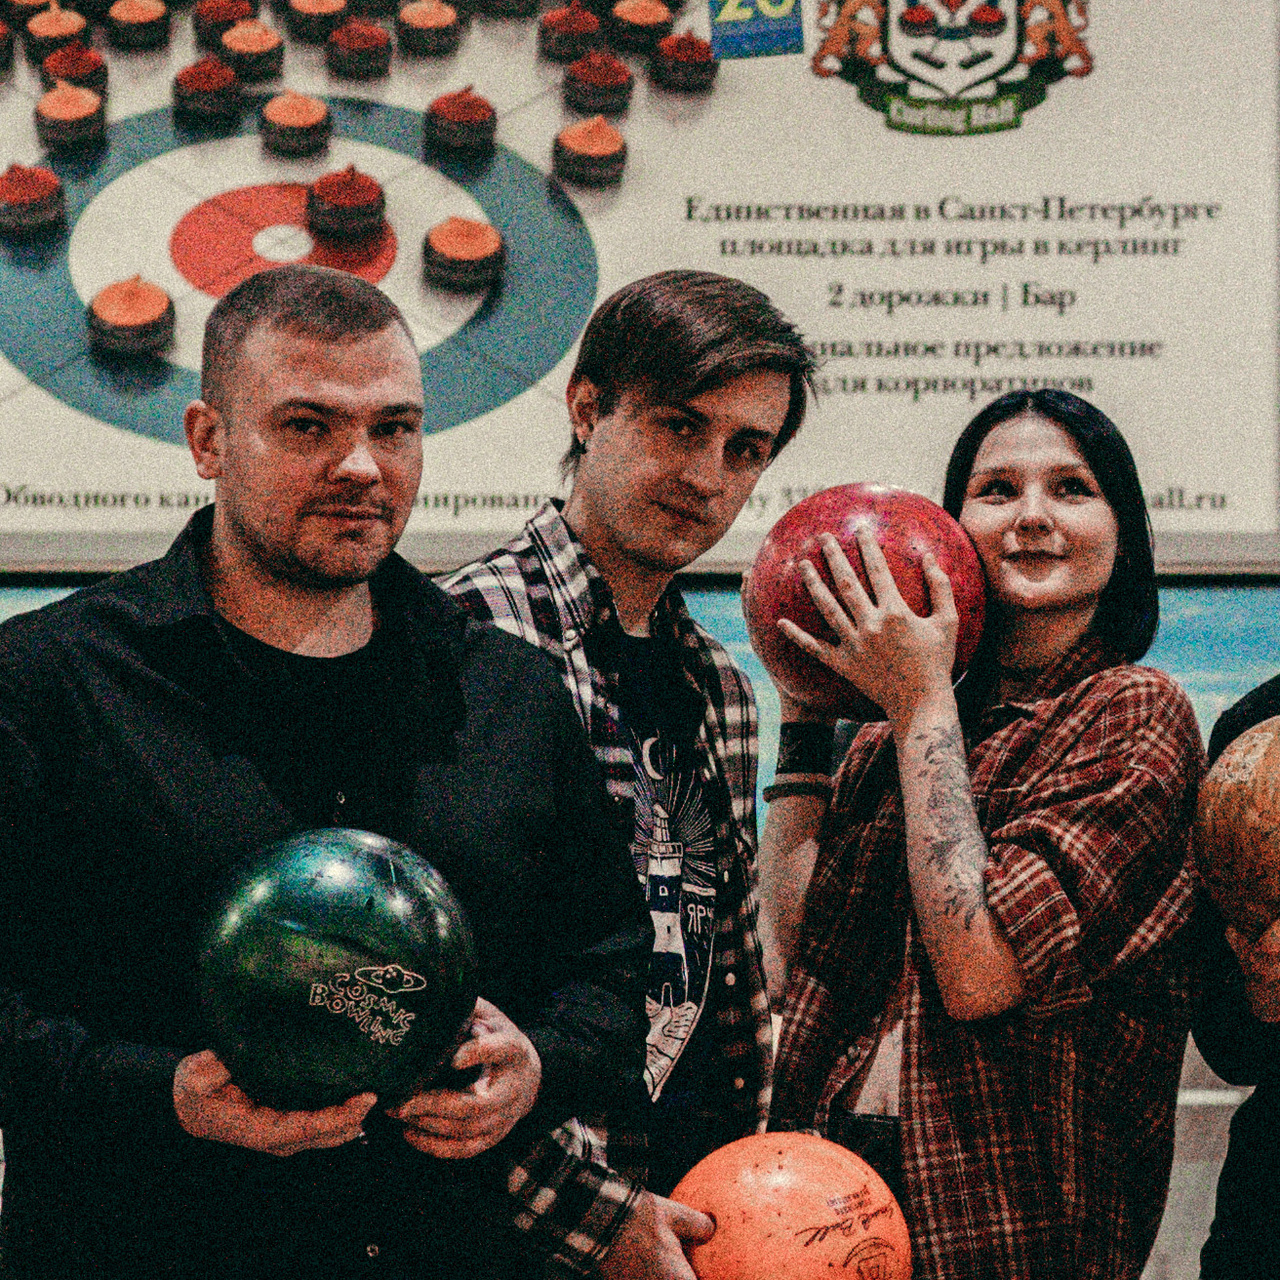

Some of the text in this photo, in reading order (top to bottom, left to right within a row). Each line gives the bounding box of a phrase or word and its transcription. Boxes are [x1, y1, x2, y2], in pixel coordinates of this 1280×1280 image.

[683, 195, 1222, 231] Единственная в Санкт-Петербурге
[718, 236, 1185, 265] площадка для игры в керлинг
[827, 281, 844, 308] 2
[849, 287, 990, 315] дорожки
[1020, 281, 1077, 315] Бар
[811, 339, 1164, 367] иальное предложение
[308, 982, 406, 1046] BOWLING
